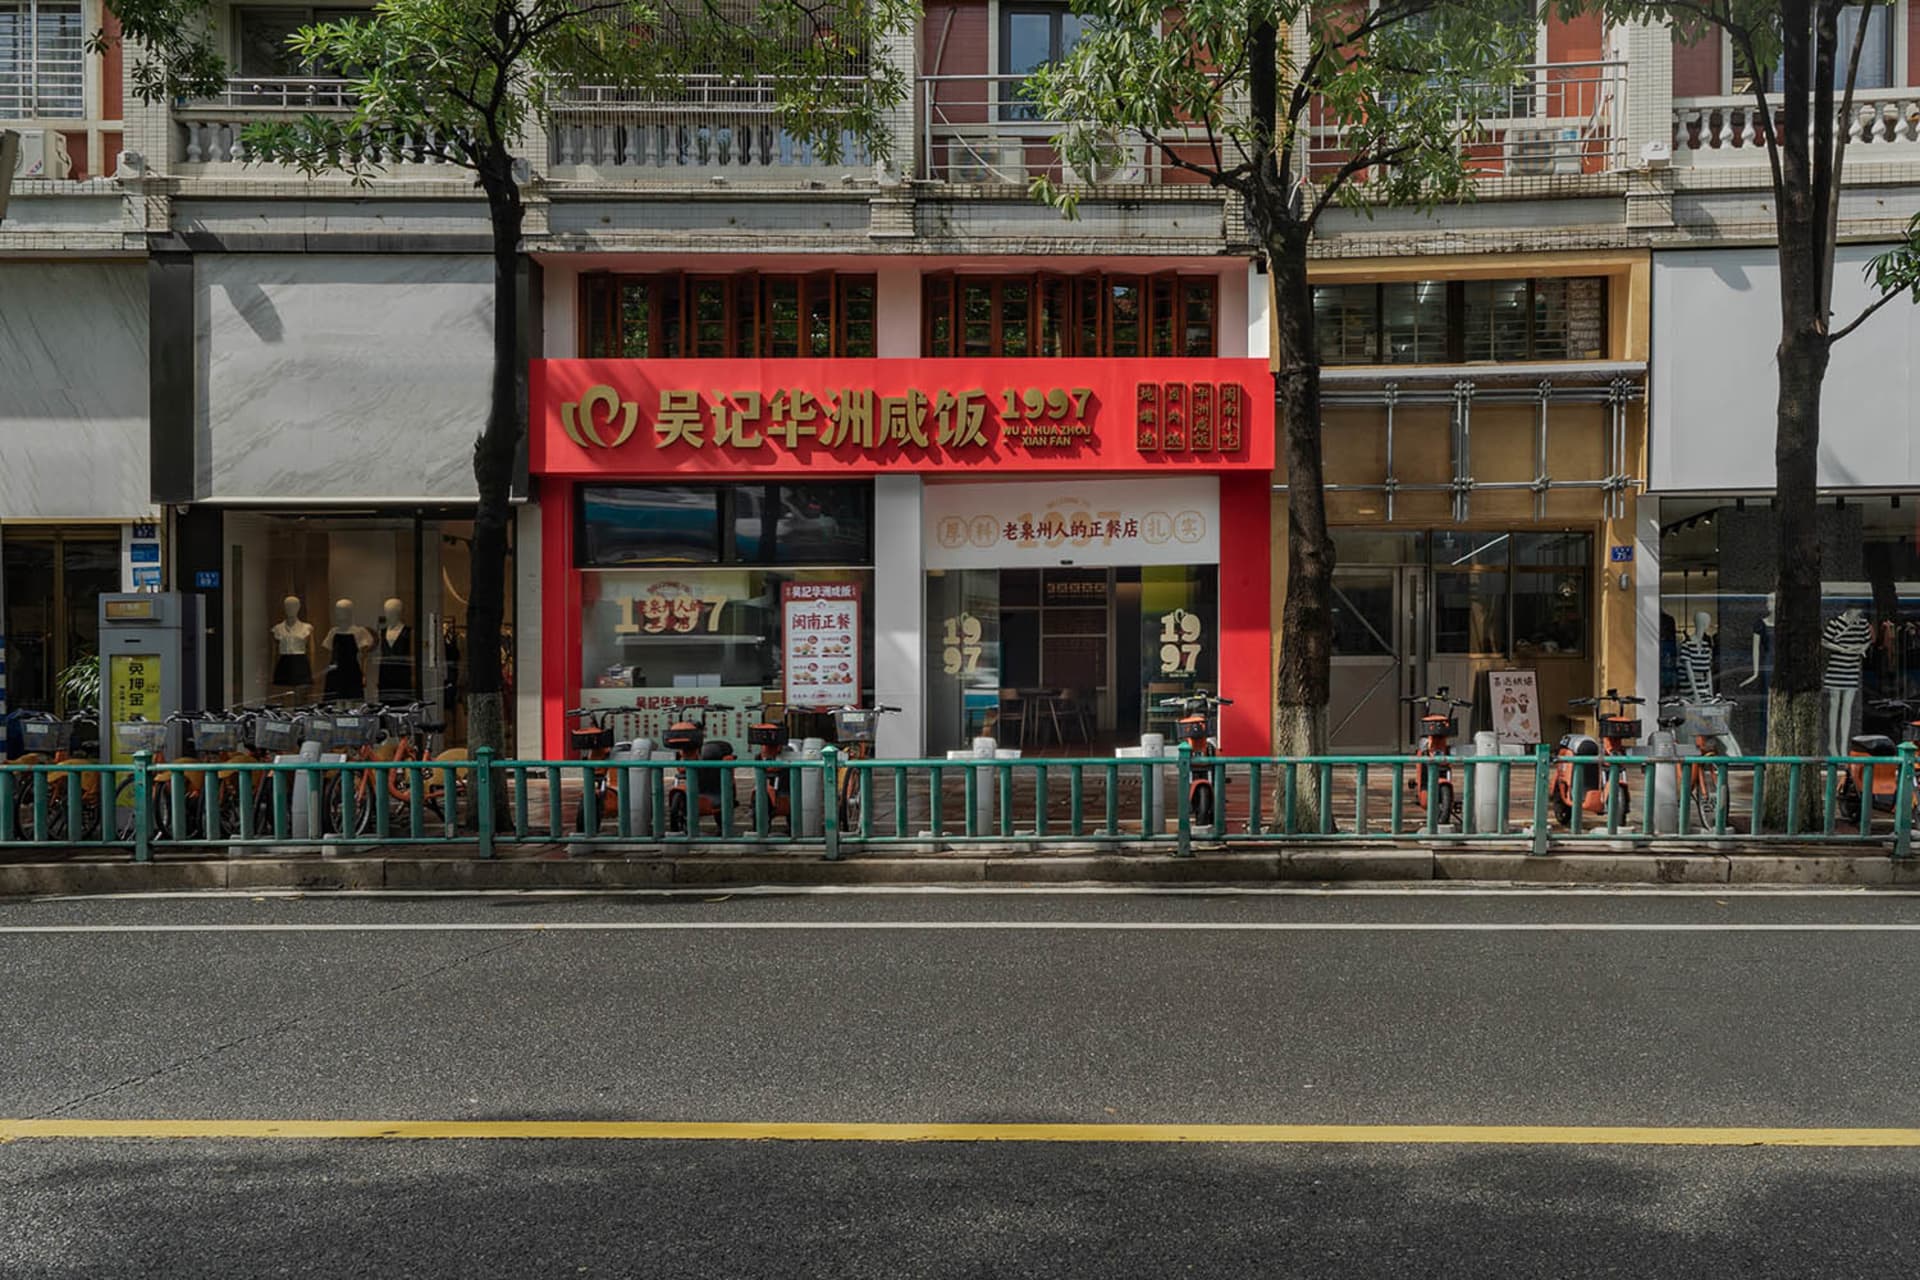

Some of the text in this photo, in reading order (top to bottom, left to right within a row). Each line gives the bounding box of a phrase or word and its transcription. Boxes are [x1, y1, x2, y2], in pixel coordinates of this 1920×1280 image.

[1001, 387, 1092, 419] 1997
[655, 388, 988, 449] 吴记华洲咸饭
[1003, 425, 1091, 436] WU JI HUA ZHOU
[1022, 436, 1071, 446] XIAN FAN
[1002, 518, 1139, 541] 老泉州人的正餐店
[791, 613, 852, 631] 闽南正餐
[943, 616, 982, 645] 19
[1160, 613, 1202, 643] 19
[943, 646, 982, 675] 97
[1160, 643, 1202, 673] 97
